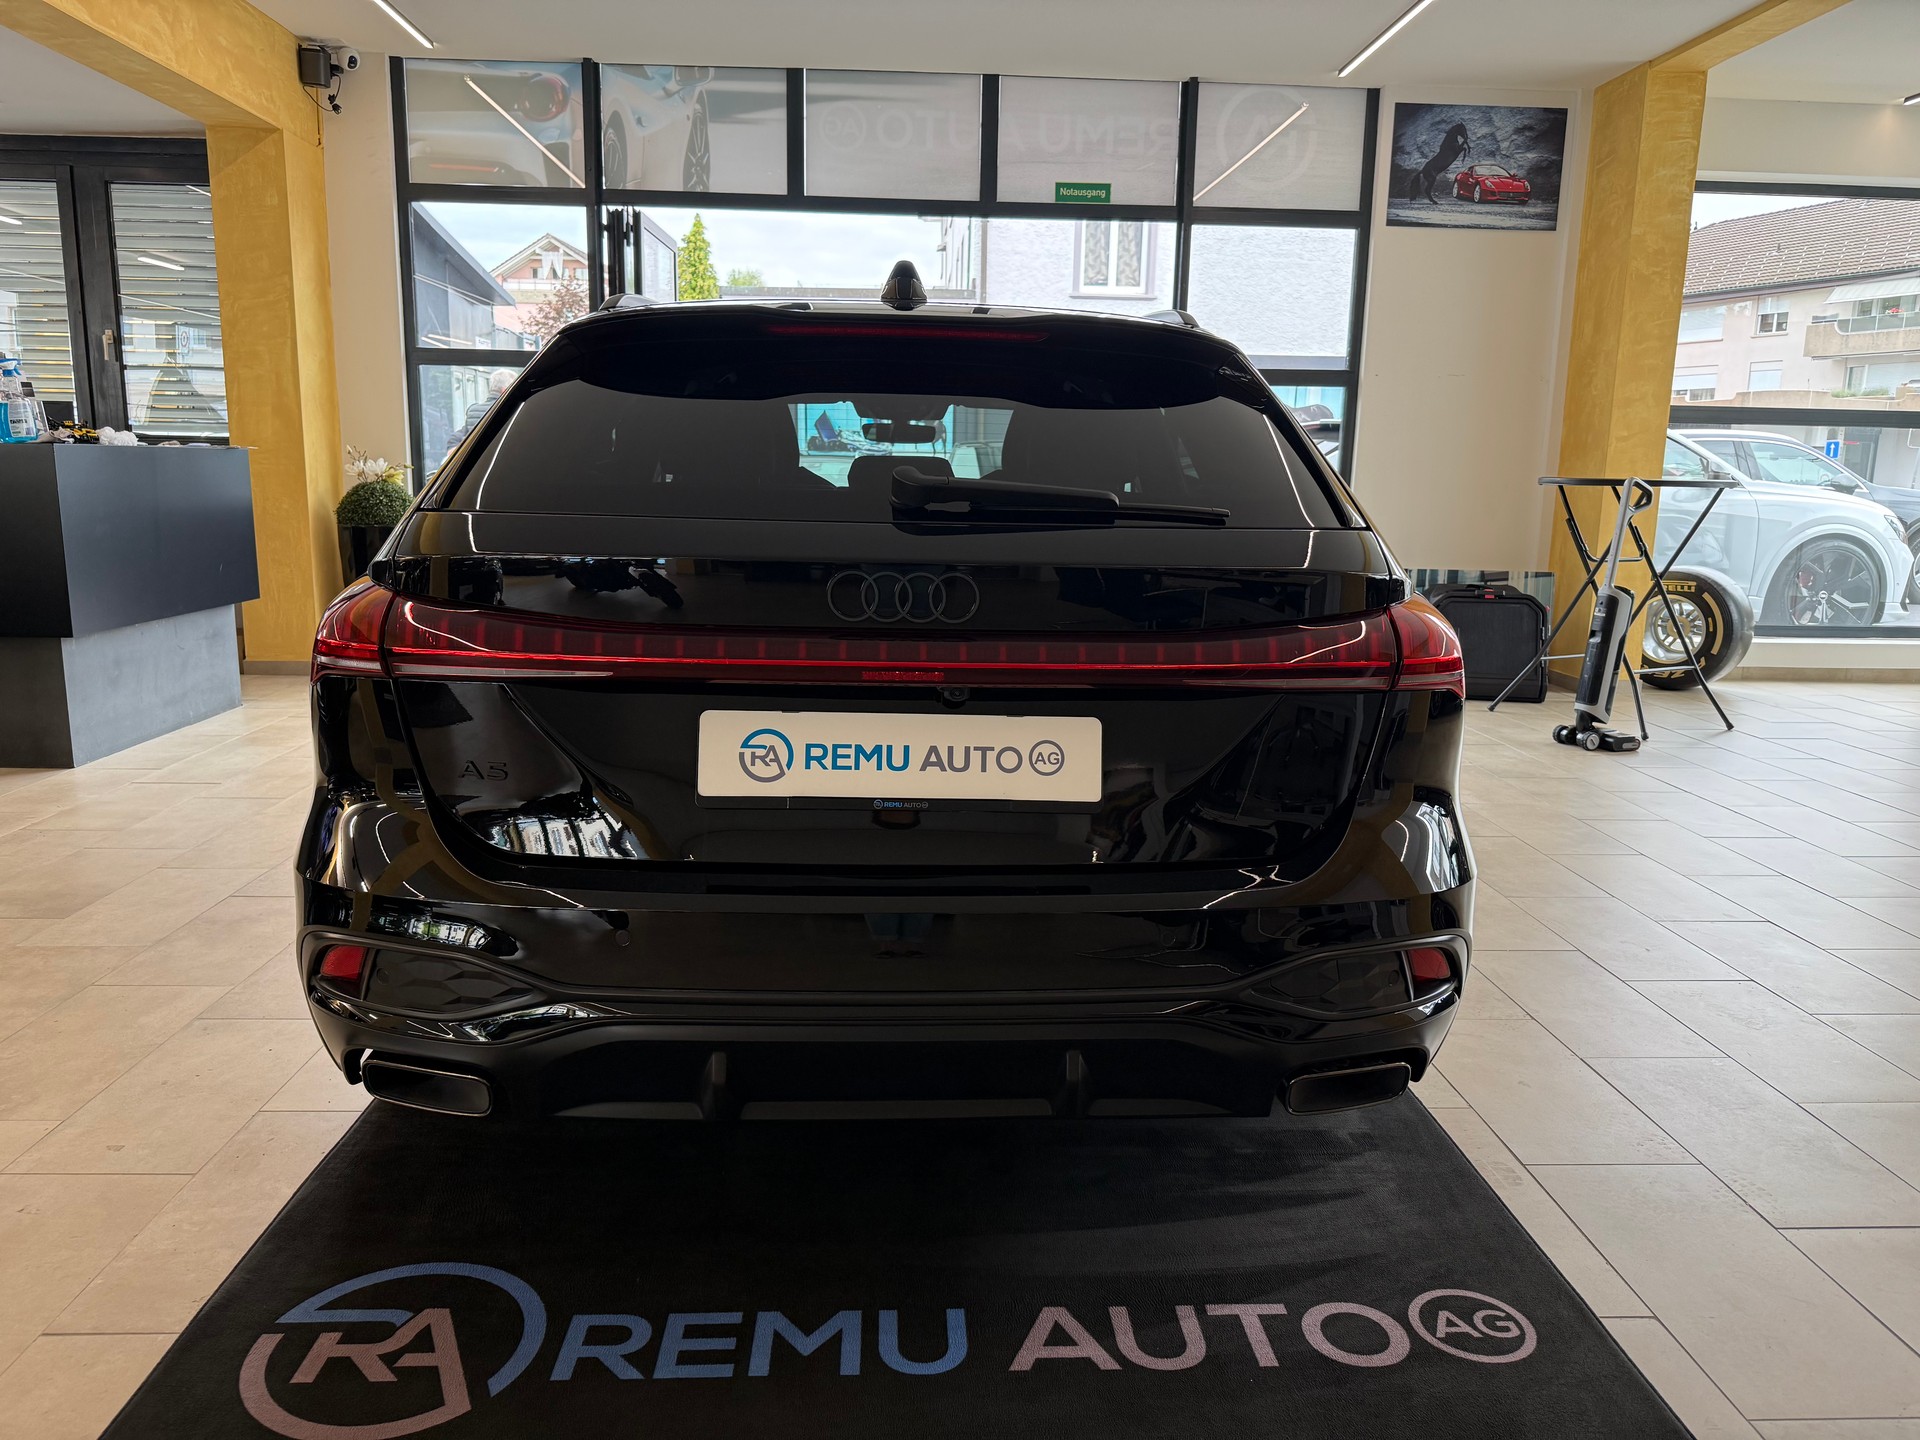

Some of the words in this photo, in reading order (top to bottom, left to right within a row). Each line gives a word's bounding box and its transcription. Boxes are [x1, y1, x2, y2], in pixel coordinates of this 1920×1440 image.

[1060, 187, 1106, 199] Notausgang
[458, 760, 509, 781] A5
[804, 743, 910, 772] REMU
[919, 745, 1023, 774] AUTO
[1034, 751, 1060, 766] AG
[550, 1308, 968, 1382] REMU
[1008, 1302, 1411, 1371] AUTO
[1432, 1308, 1522, 1339] AG
